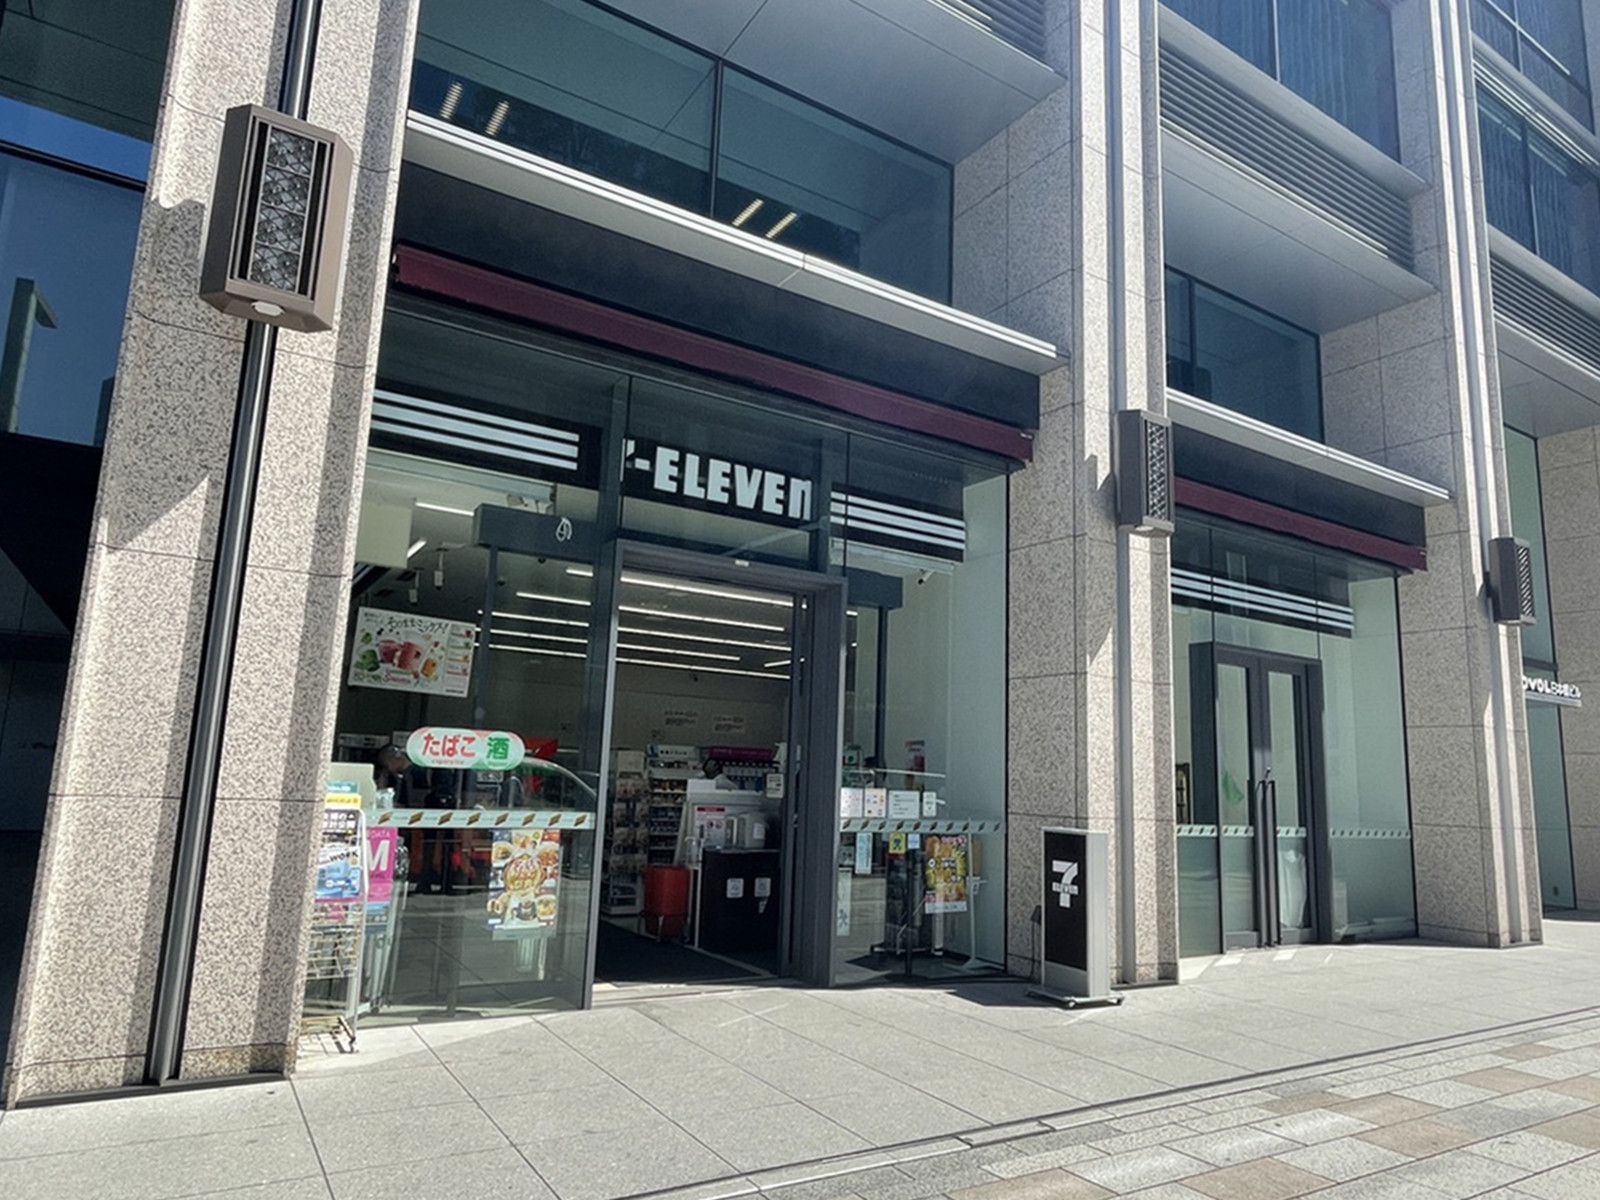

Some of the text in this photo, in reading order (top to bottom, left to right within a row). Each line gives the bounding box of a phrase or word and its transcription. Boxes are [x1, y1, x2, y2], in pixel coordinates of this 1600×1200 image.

[421, 733, 510, 760] たばこ 酒
